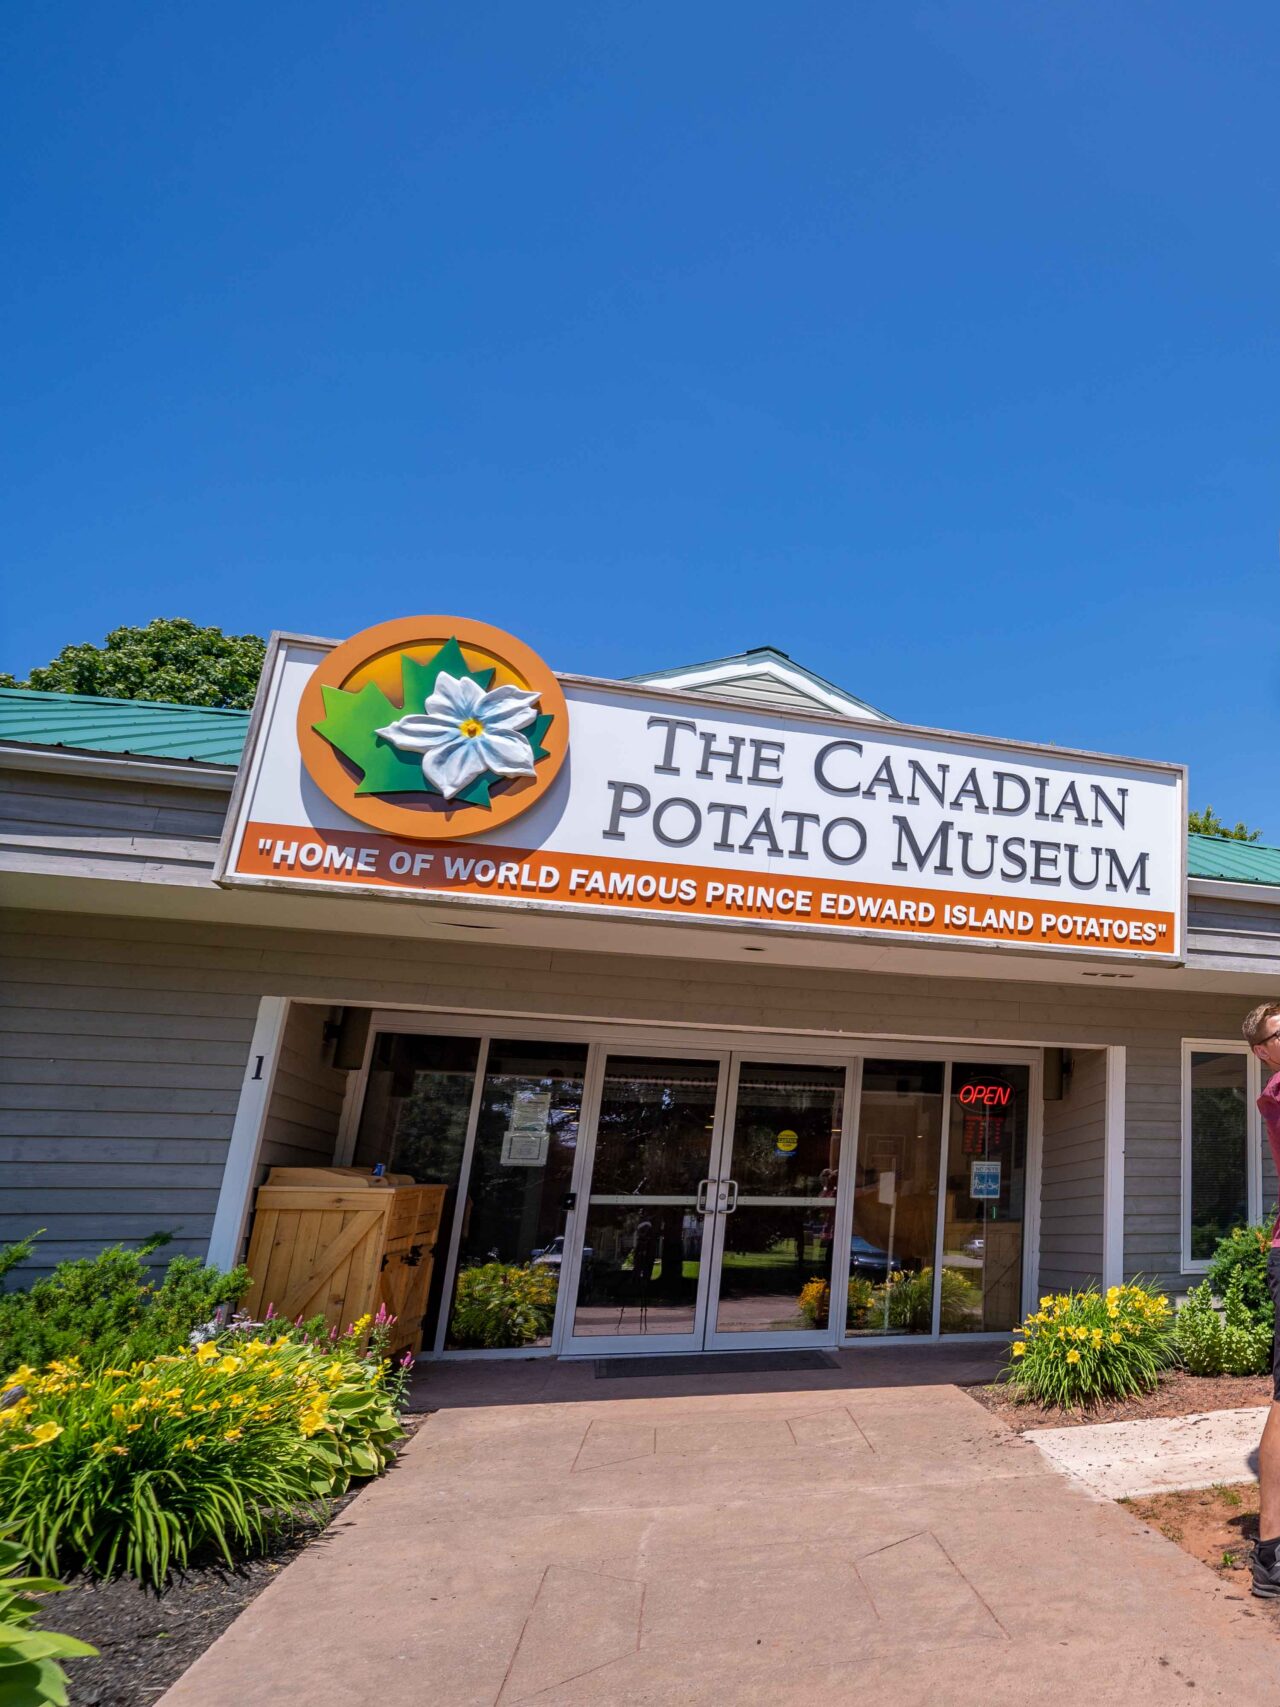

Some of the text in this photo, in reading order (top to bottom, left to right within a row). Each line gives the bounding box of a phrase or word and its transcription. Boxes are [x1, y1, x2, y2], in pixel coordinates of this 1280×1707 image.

[647, 716, 1129, 830] THE CANADIAN
[602, 780, 1150, 895] POTATO MUSEUM
[258, 839, 1167, 943] "HOME OF WORLD FAMOUS PRINCE EDWARD ISLAND POTATOES"
[251, 1055, 264, 1080] 1
[959, 1085, 1011, 1105] OPEN
